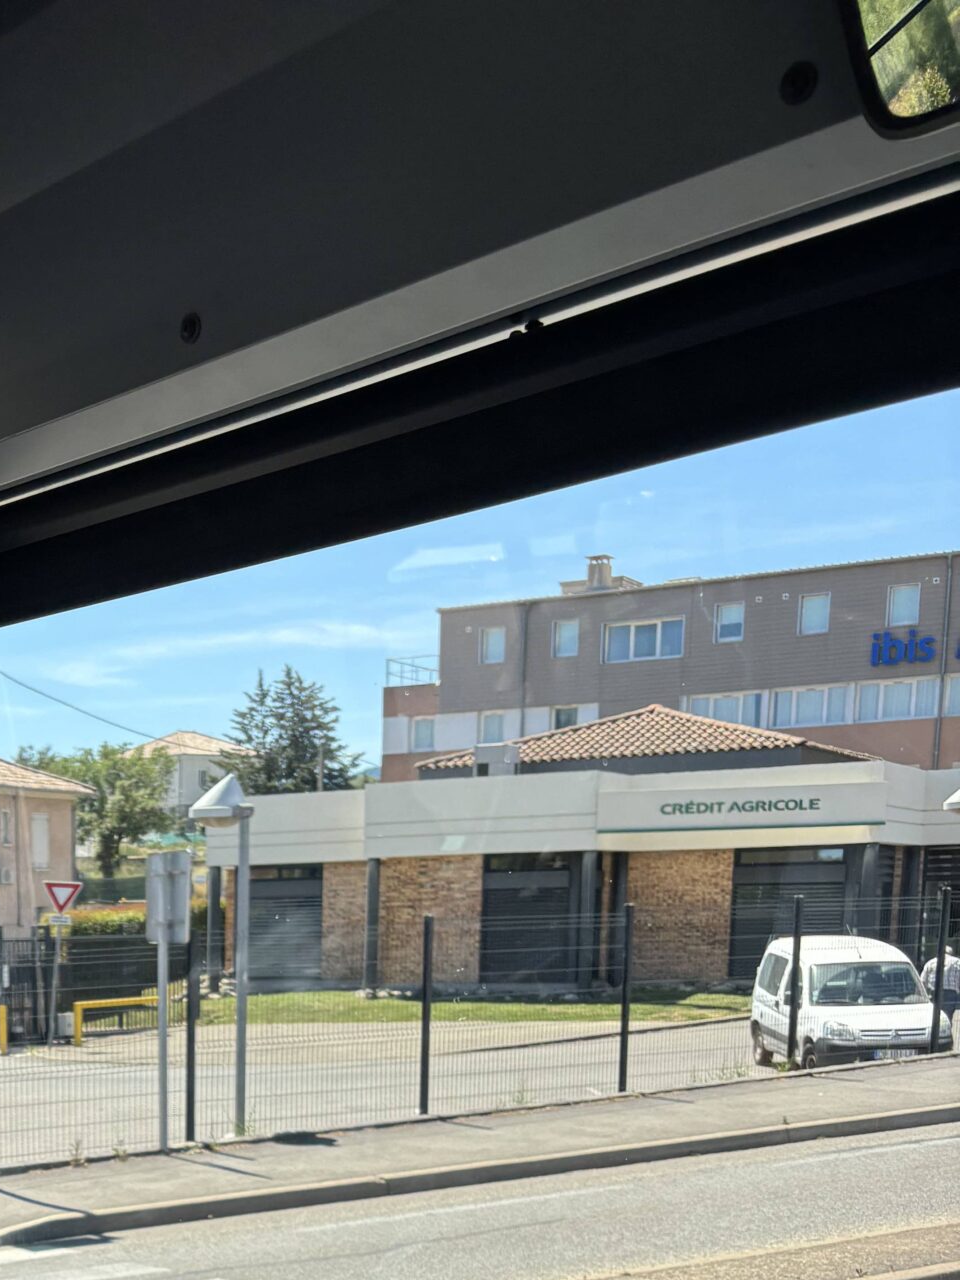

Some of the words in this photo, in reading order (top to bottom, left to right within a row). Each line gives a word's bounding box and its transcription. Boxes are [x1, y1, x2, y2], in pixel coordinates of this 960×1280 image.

[870, 629, 937, 667] ibis
[659, 799, 725, 815] CRÉDIT
[729, 797, 821, 814] AGRICOLE
